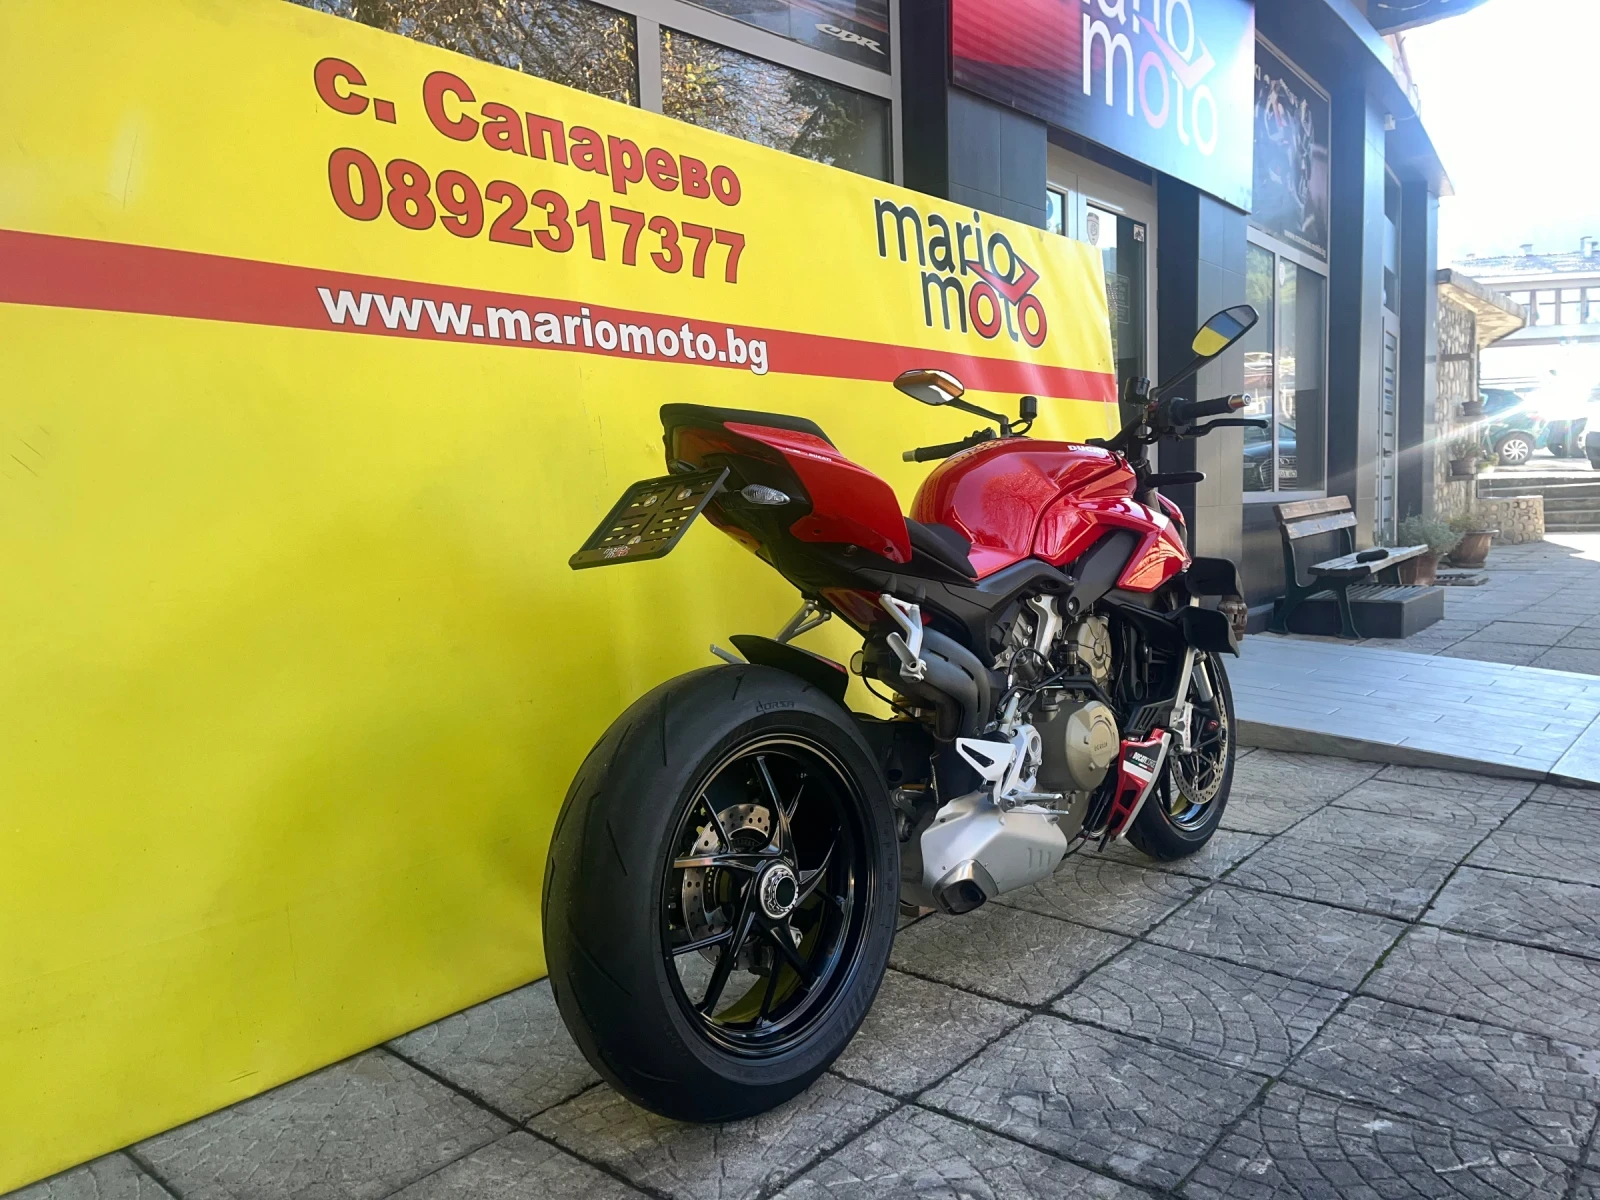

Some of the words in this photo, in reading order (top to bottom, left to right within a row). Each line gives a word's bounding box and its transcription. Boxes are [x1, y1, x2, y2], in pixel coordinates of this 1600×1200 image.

[814, 23, 886, 56] CBR
[1083, 13, 1218, 156] moto
[313, 57, 397, 124] с.
[423, 71, 742, 206] Сапарево
[328, 147, 746, 284] 0892317377
[874, 198, 1016, 285] mario
[316, 286, 769, 375] www.mariomoto.bg
[921, 272, 1047, 348] moto
[756, 700, 795, 713] CORSA
